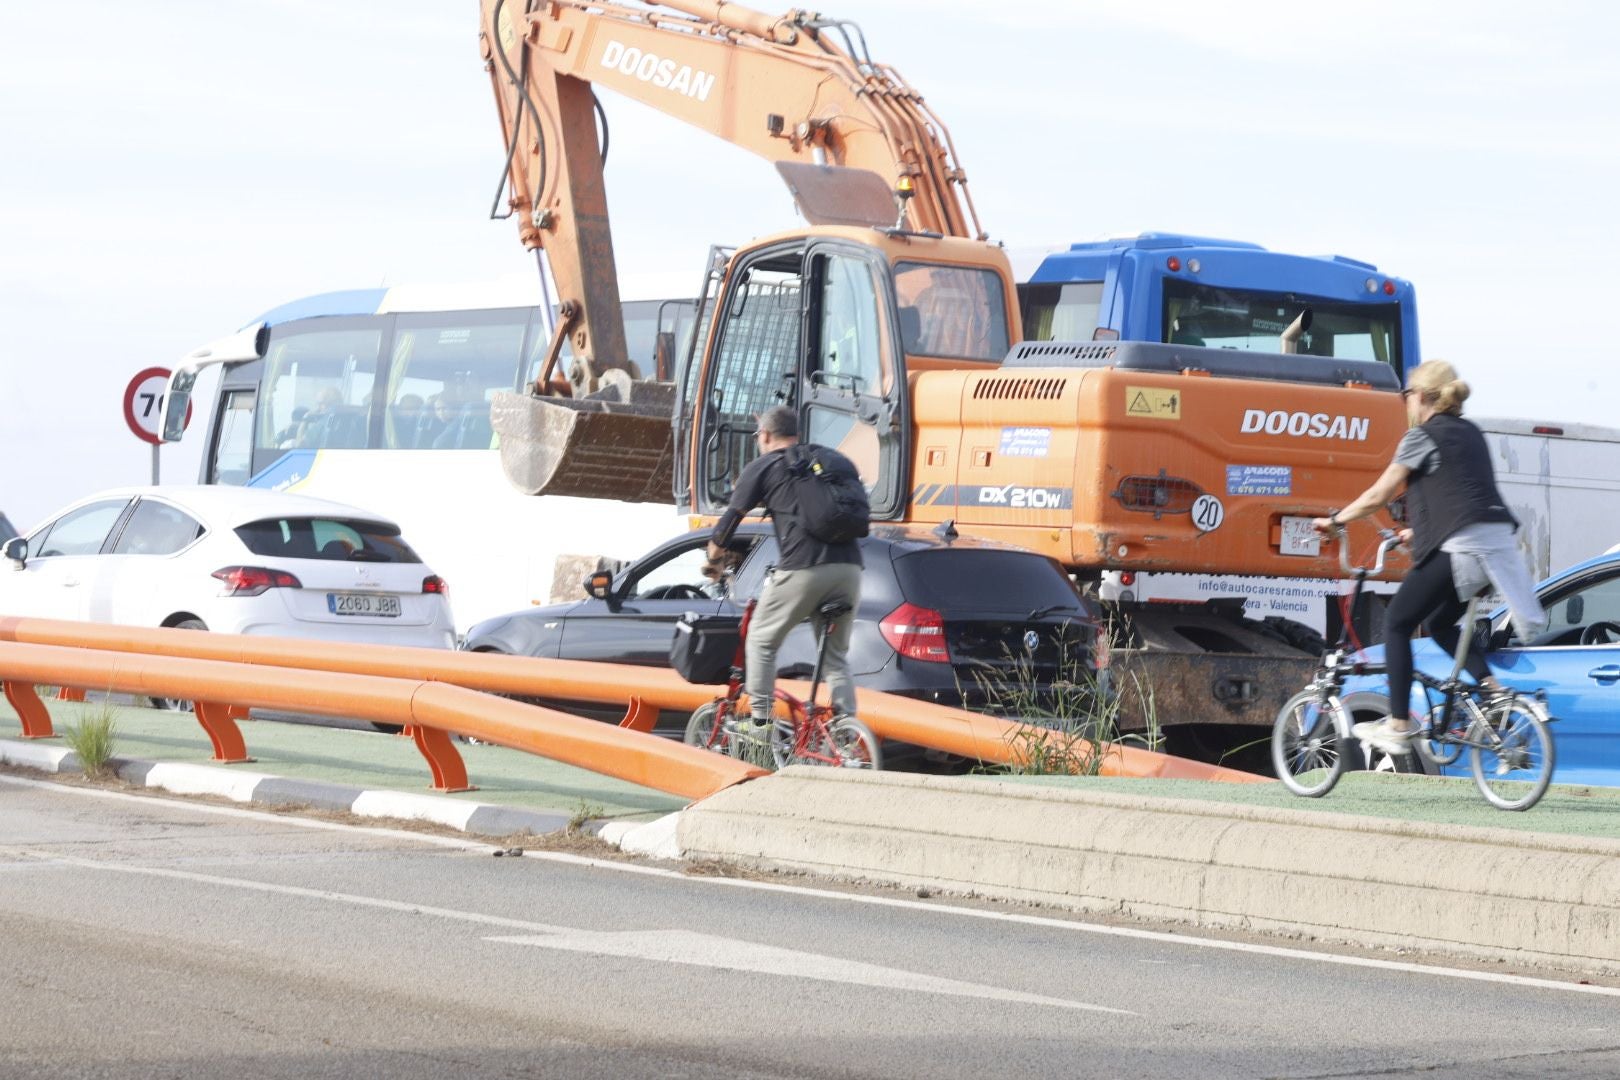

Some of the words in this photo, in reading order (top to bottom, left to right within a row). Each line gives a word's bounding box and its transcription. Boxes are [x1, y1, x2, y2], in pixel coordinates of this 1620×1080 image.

[600, 40, 716, 102] DOOSAN
[140, 393, 165, 417] 7
[1240, 409, 1370, 441] DOOSAN
[1197, 498, 1219, 527] 20
[1269, 599, 1308, 612] Valencia
